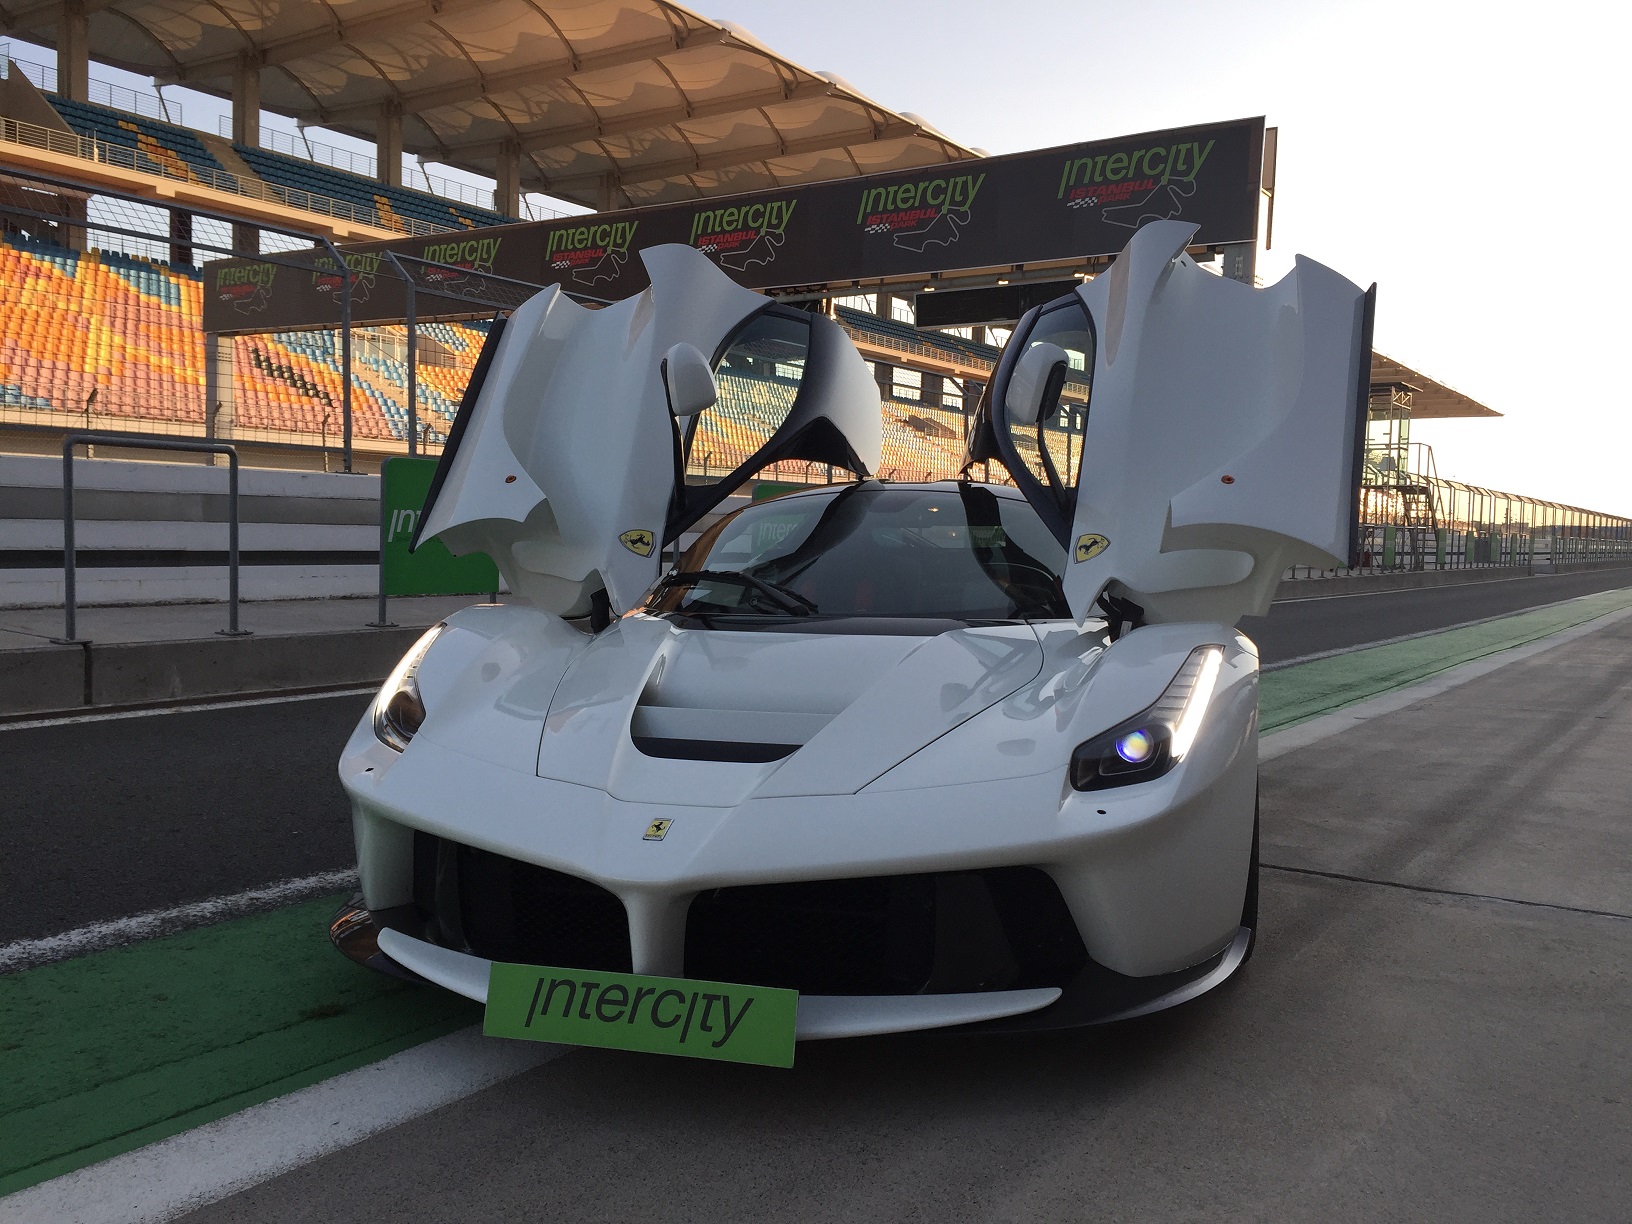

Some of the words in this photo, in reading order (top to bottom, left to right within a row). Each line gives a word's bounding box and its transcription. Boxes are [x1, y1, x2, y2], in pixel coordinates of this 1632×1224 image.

[1069, 179, 1156, 199] ISTANBUL
[1098, 192, 1132, 205] PARK
[867, 208, 938, 225] ISTANBUL
[890, 220, 917, 231] PARK
[698, 230, 757, 246] ISTANBUL
[716, 241, 741, 252] PARK
[552, 248, 605, 262] ISTANBUL
